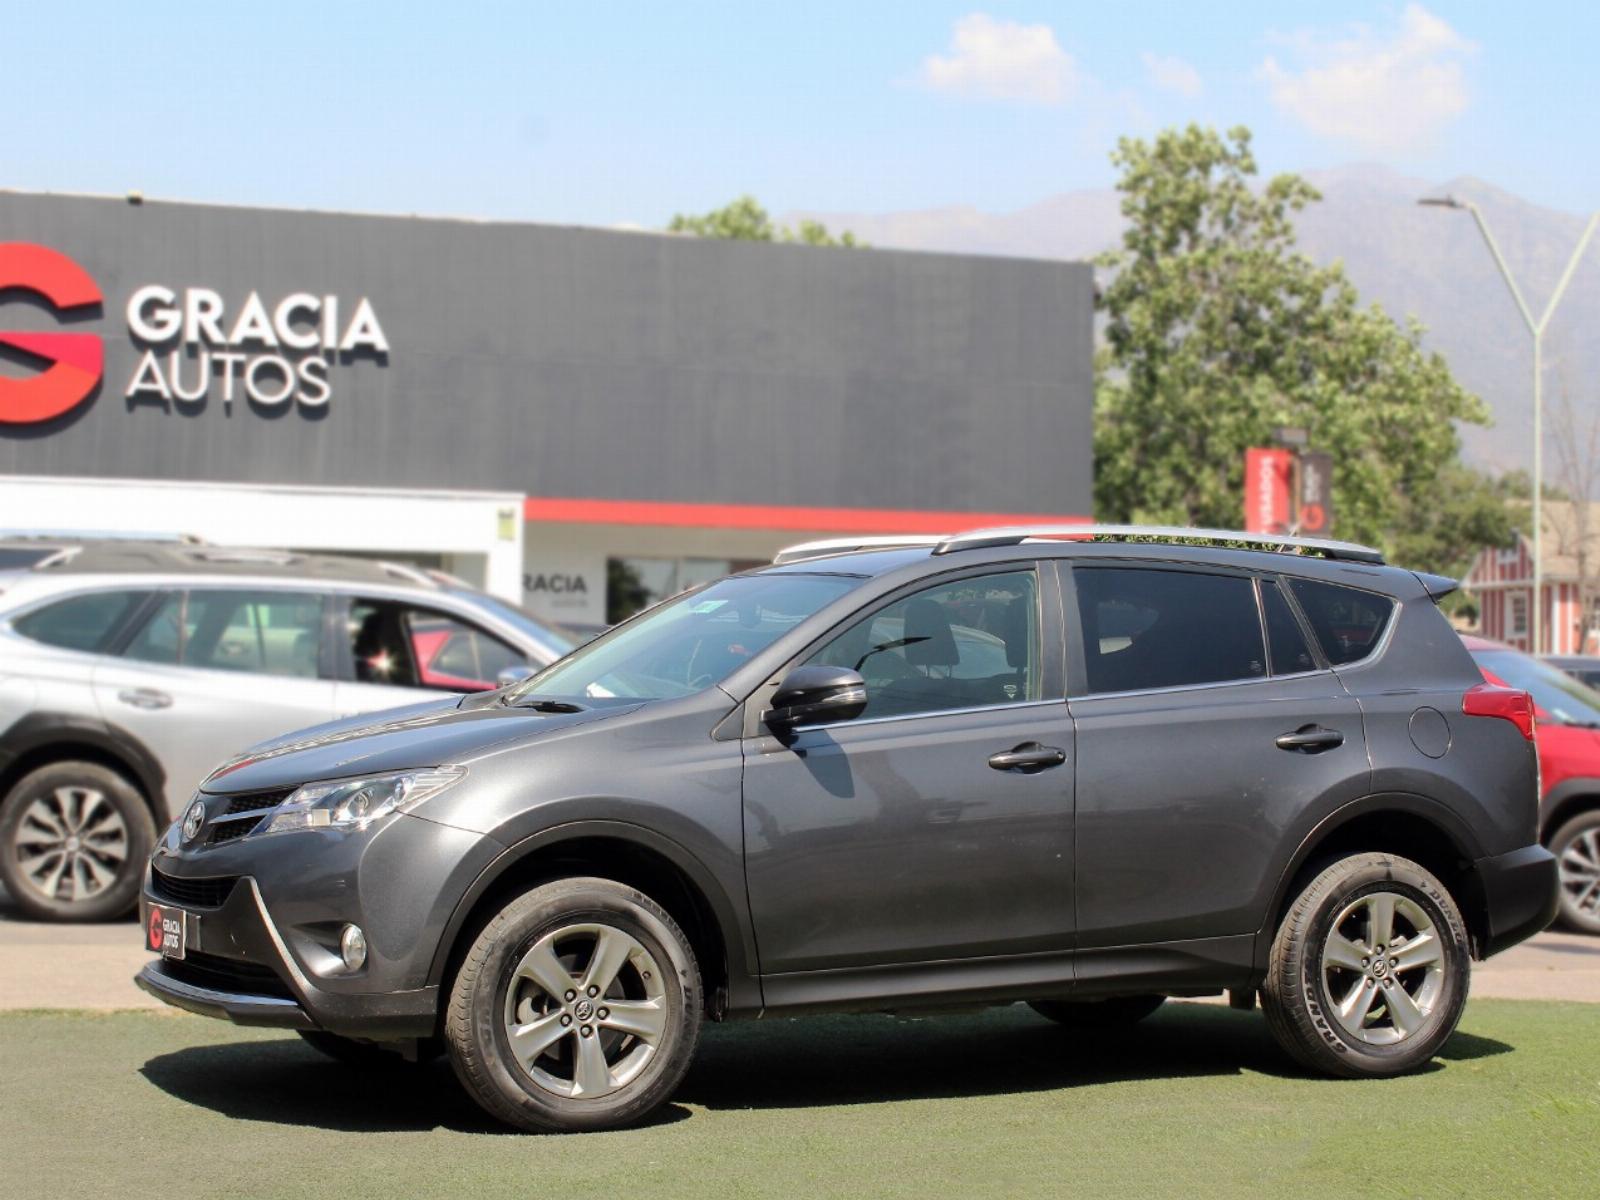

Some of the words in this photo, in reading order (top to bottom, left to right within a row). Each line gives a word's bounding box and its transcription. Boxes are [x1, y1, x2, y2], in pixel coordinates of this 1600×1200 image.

[126, 285, 389, 352] GRACIA
[126, 349, 332, 406] AUTOS
[522, 572, 588, 595] RACIA
[163, 918, 180, 934] GRACIA
[163, 933, 179, 948] AUTOS
